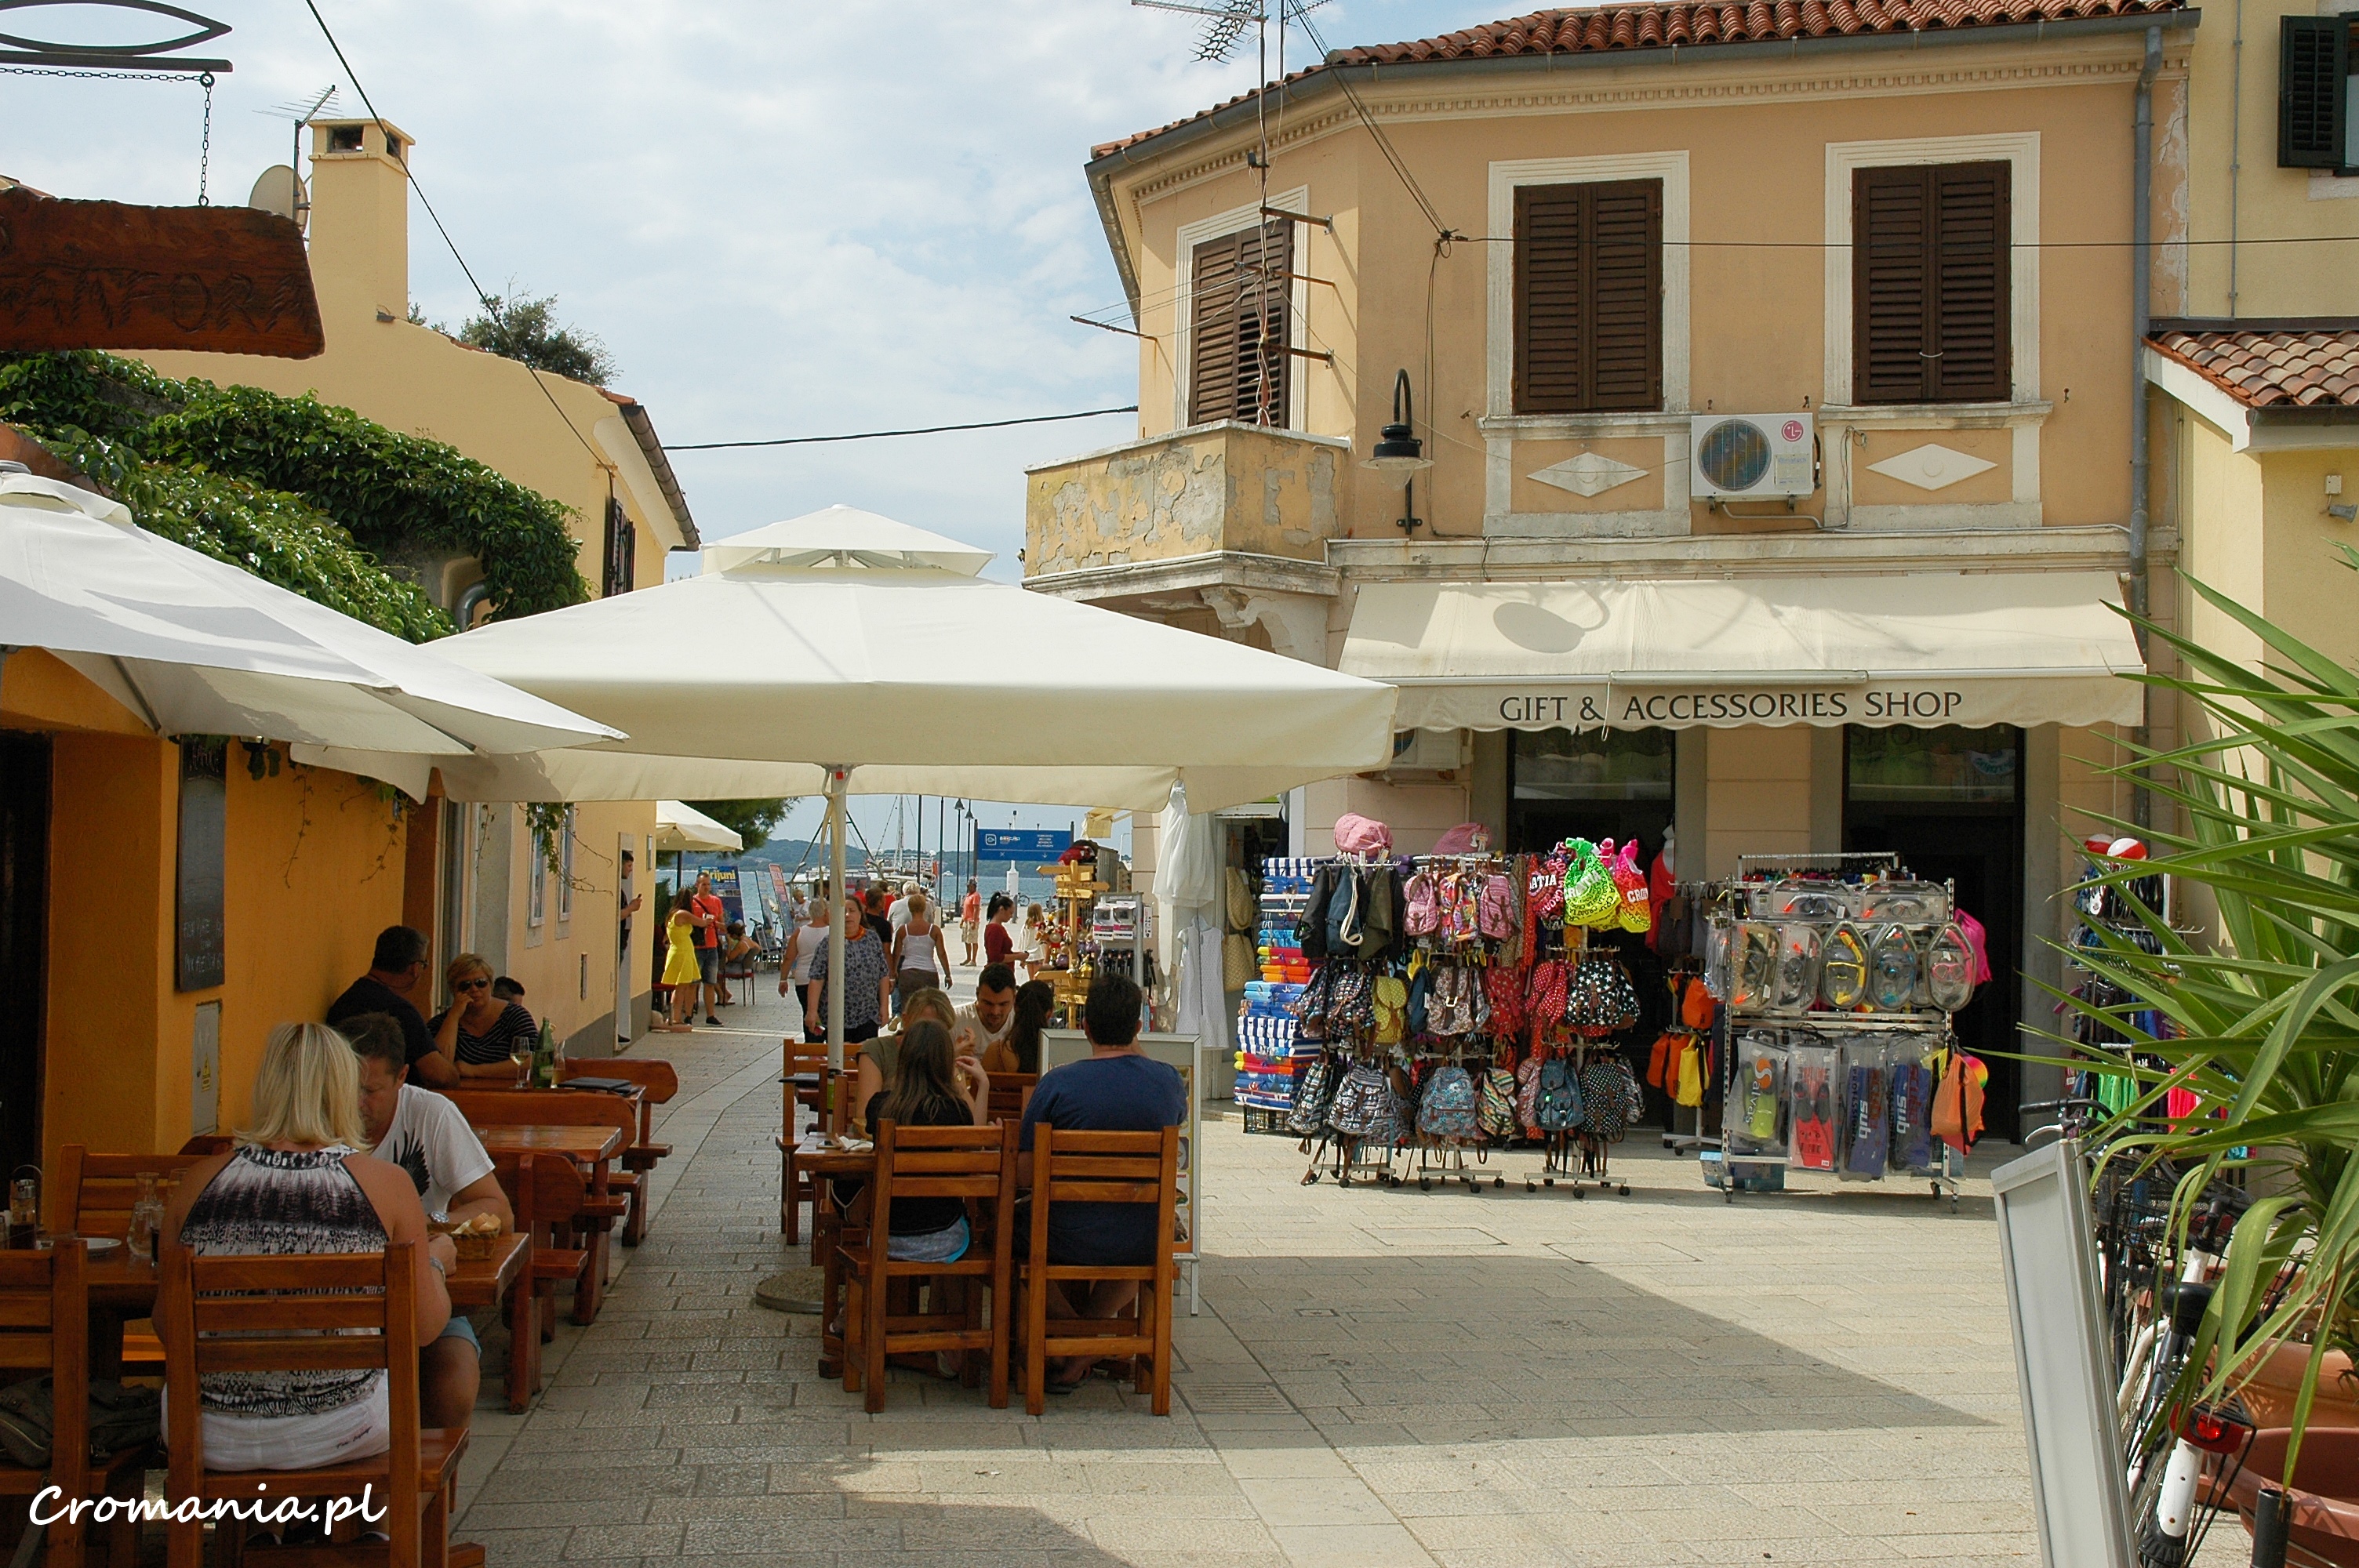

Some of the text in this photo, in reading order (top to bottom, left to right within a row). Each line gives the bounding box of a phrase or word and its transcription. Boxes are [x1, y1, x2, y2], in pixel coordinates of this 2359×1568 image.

[1499, 691, 1963, 722] GIFT & ACCESSORIES SHOP
[1529, 874, 1557, 890] ATIA
[1743, 1061, 1772, 1124] Salvas
[1850, 1068, 1859, 1149] PROFESSIONAL
[1908, 1064, 1922, 1127] scuba
[1858, 1099, 1872, 1139] sub
[1896, 1094, 1910, 1134] sub
